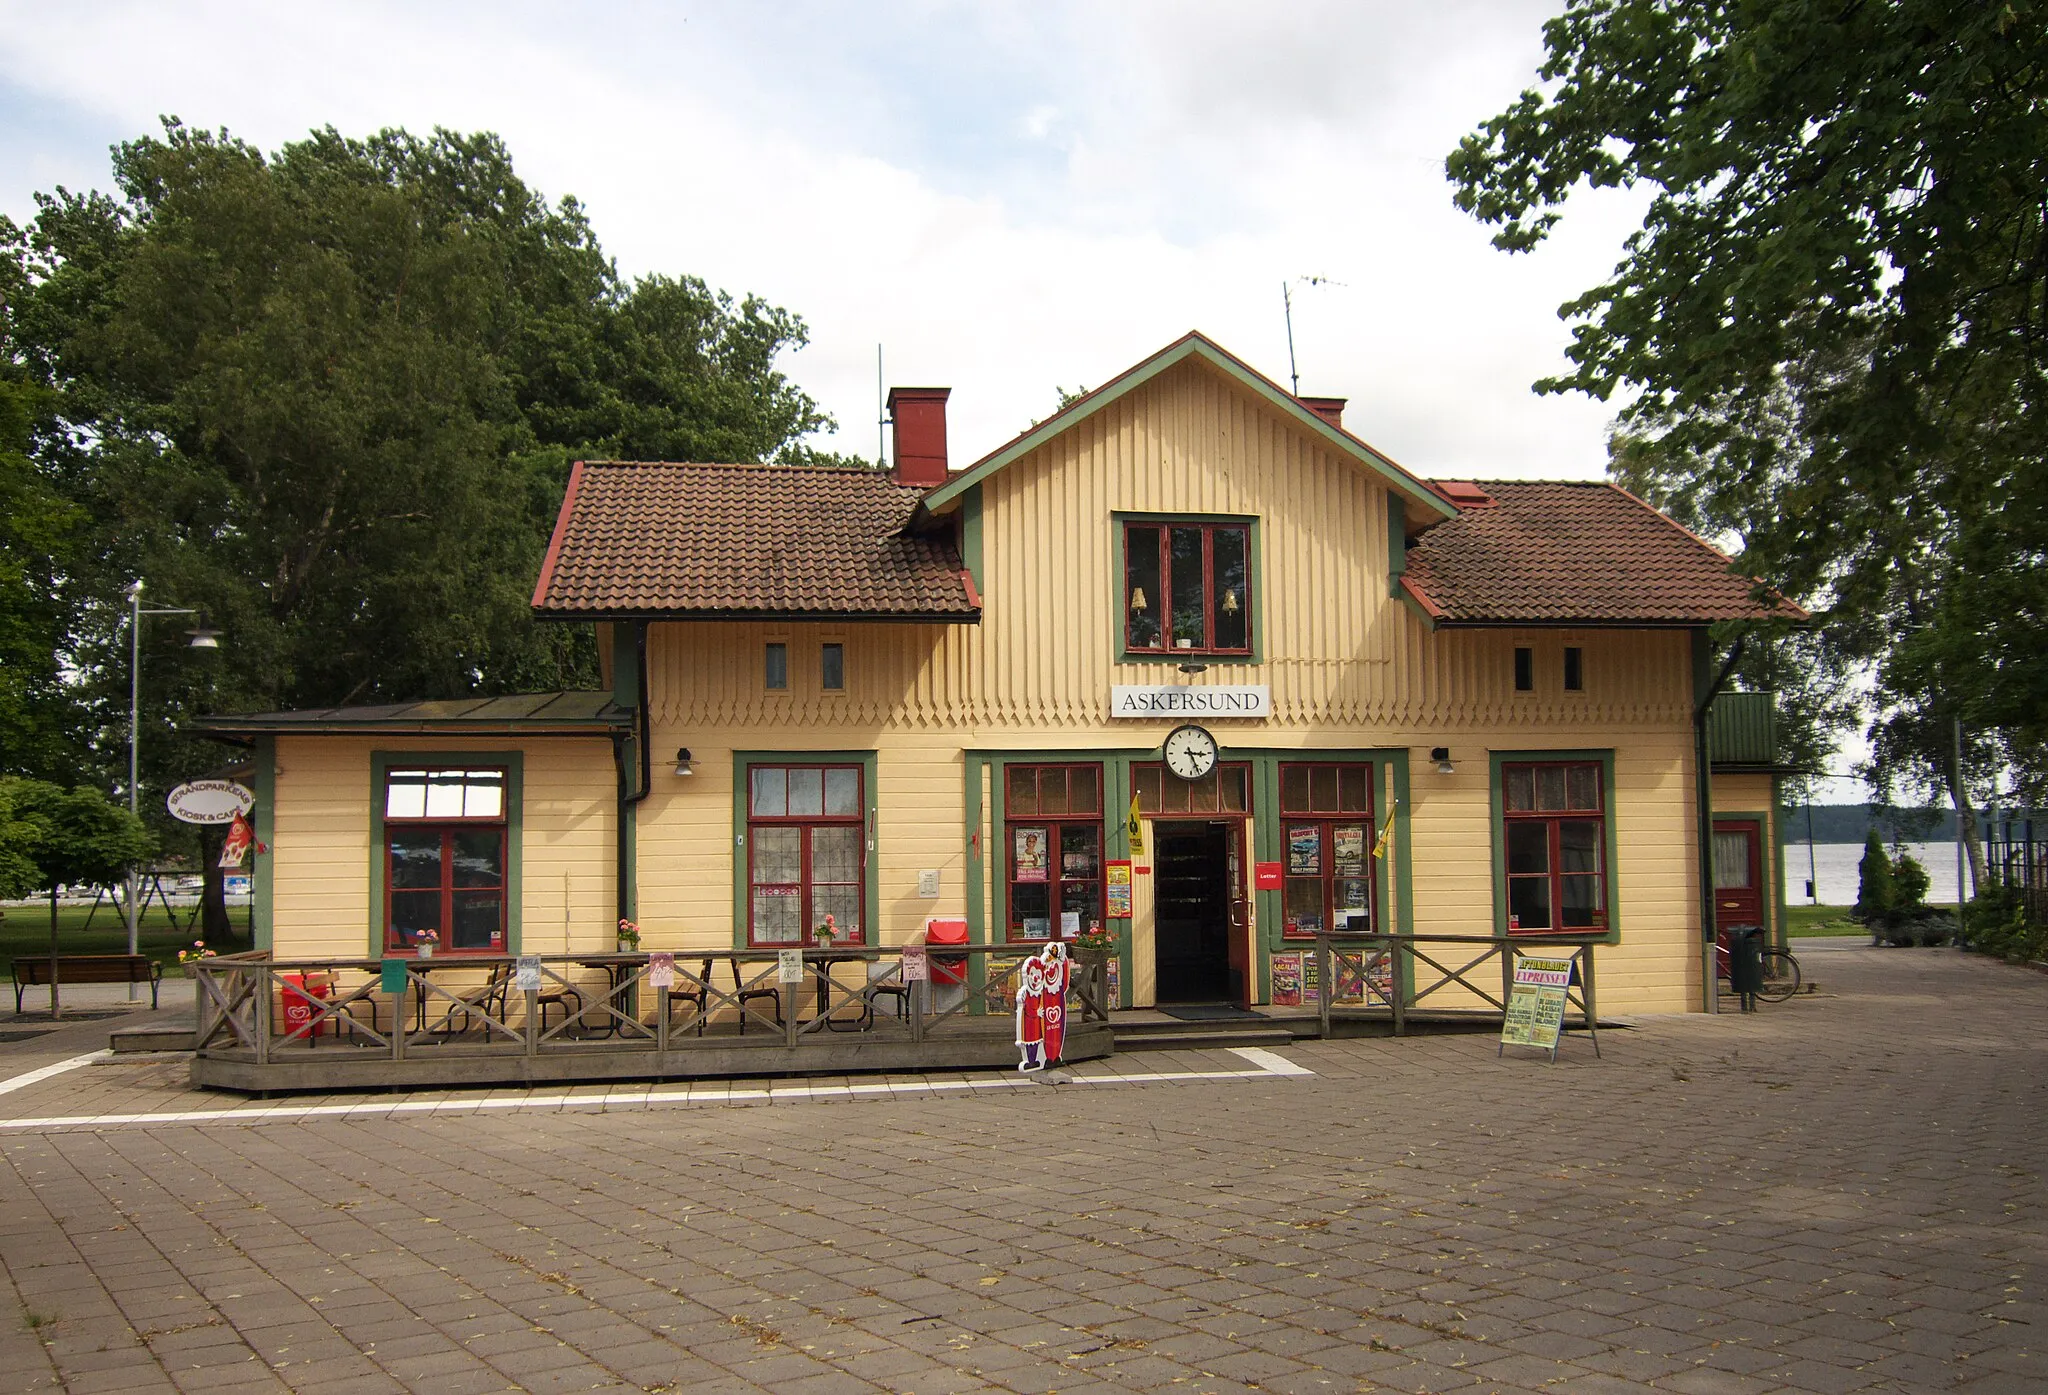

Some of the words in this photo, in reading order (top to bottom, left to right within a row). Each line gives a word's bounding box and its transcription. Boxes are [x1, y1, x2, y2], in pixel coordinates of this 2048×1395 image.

[1121, 693, 1260, 711] ASKERSUND
[170, 783, 250, 805] STRANDPARKENS
[176, 807, 207, 821] KIOSK
[1518, 960, 1569, 972] AFTONBLADET
[1516, 972, 1567, 984] EXPRESSEN
